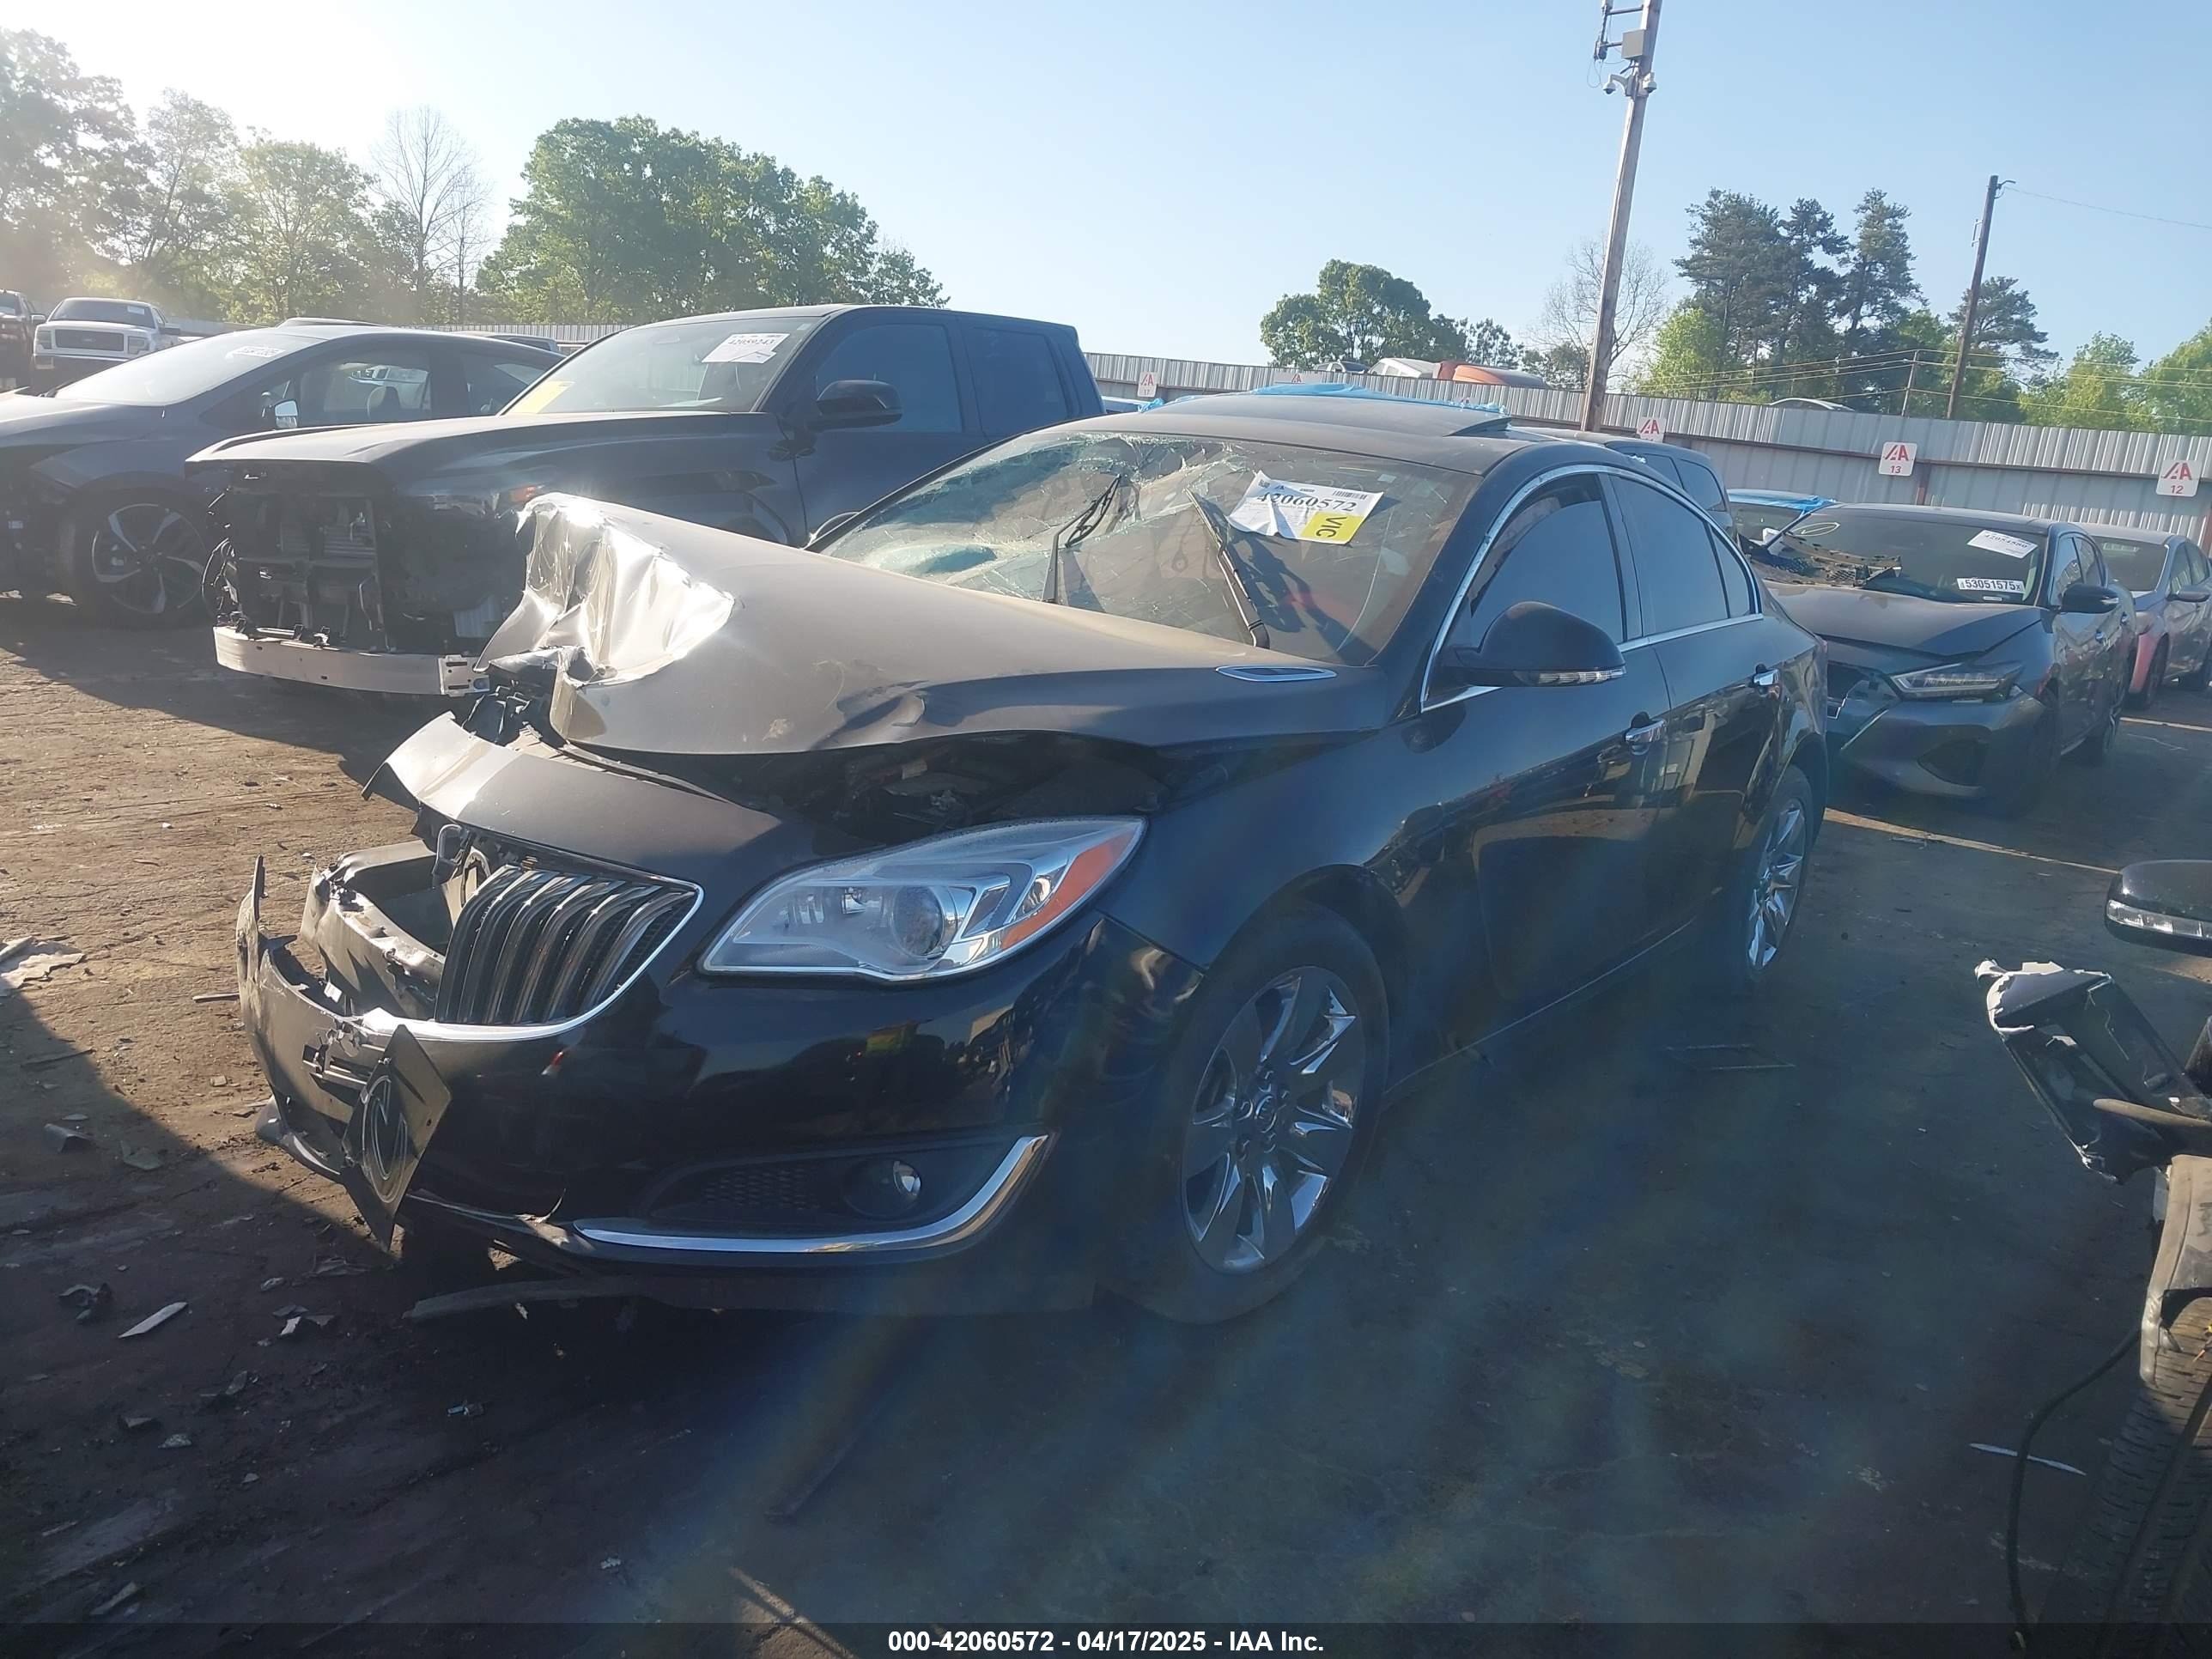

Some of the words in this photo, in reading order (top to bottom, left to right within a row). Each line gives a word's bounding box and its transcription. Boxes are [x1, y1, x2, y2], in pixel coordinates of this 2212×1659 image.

[1890, 465, 1902, 474] 13
[2171, 485, 2184, 495] 12
[1257, 492, 1358, 512] 42060572
[1316, 516, 1347, 538] VIC
